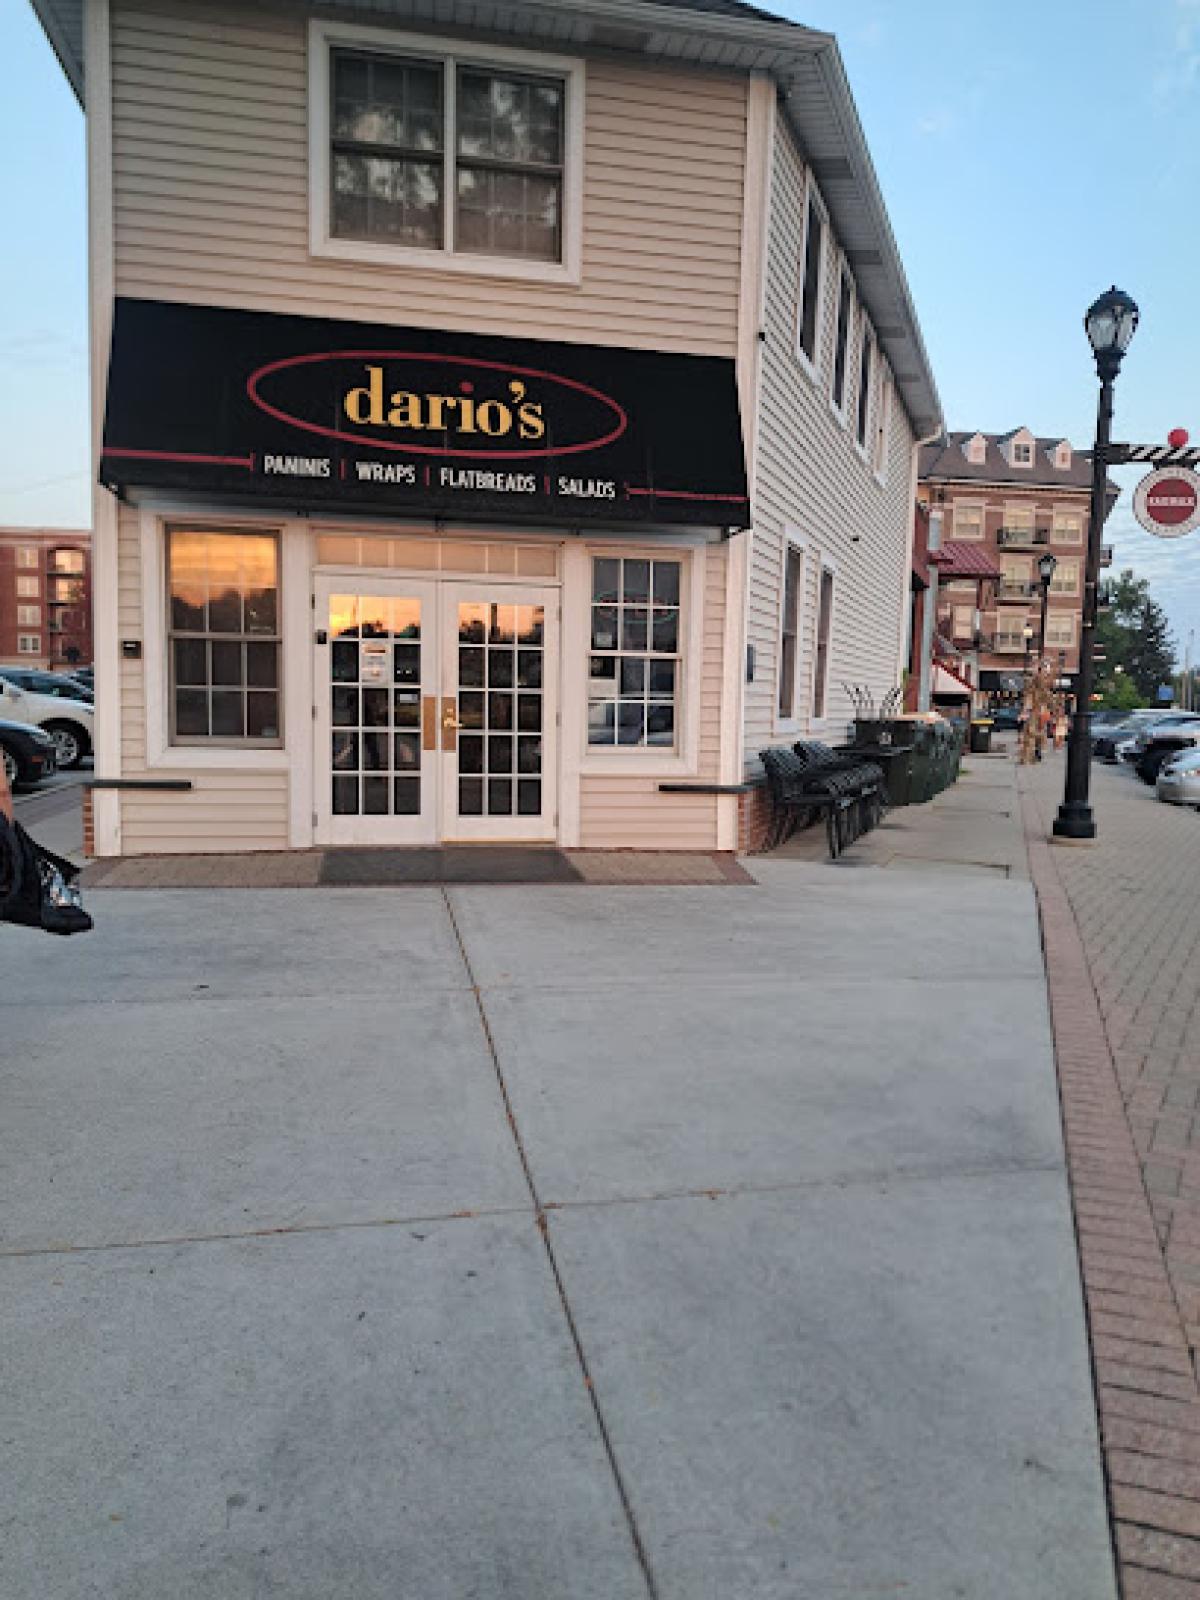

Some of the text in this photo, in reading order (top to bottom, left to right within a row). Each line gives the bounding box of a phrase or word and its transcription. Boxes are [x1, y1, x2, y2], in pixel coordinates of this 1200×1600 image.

[344, 364, 545, 439] dario's
[264, 455, 616, 500] PANINIS WRAPS FLATBREADS SALADS
